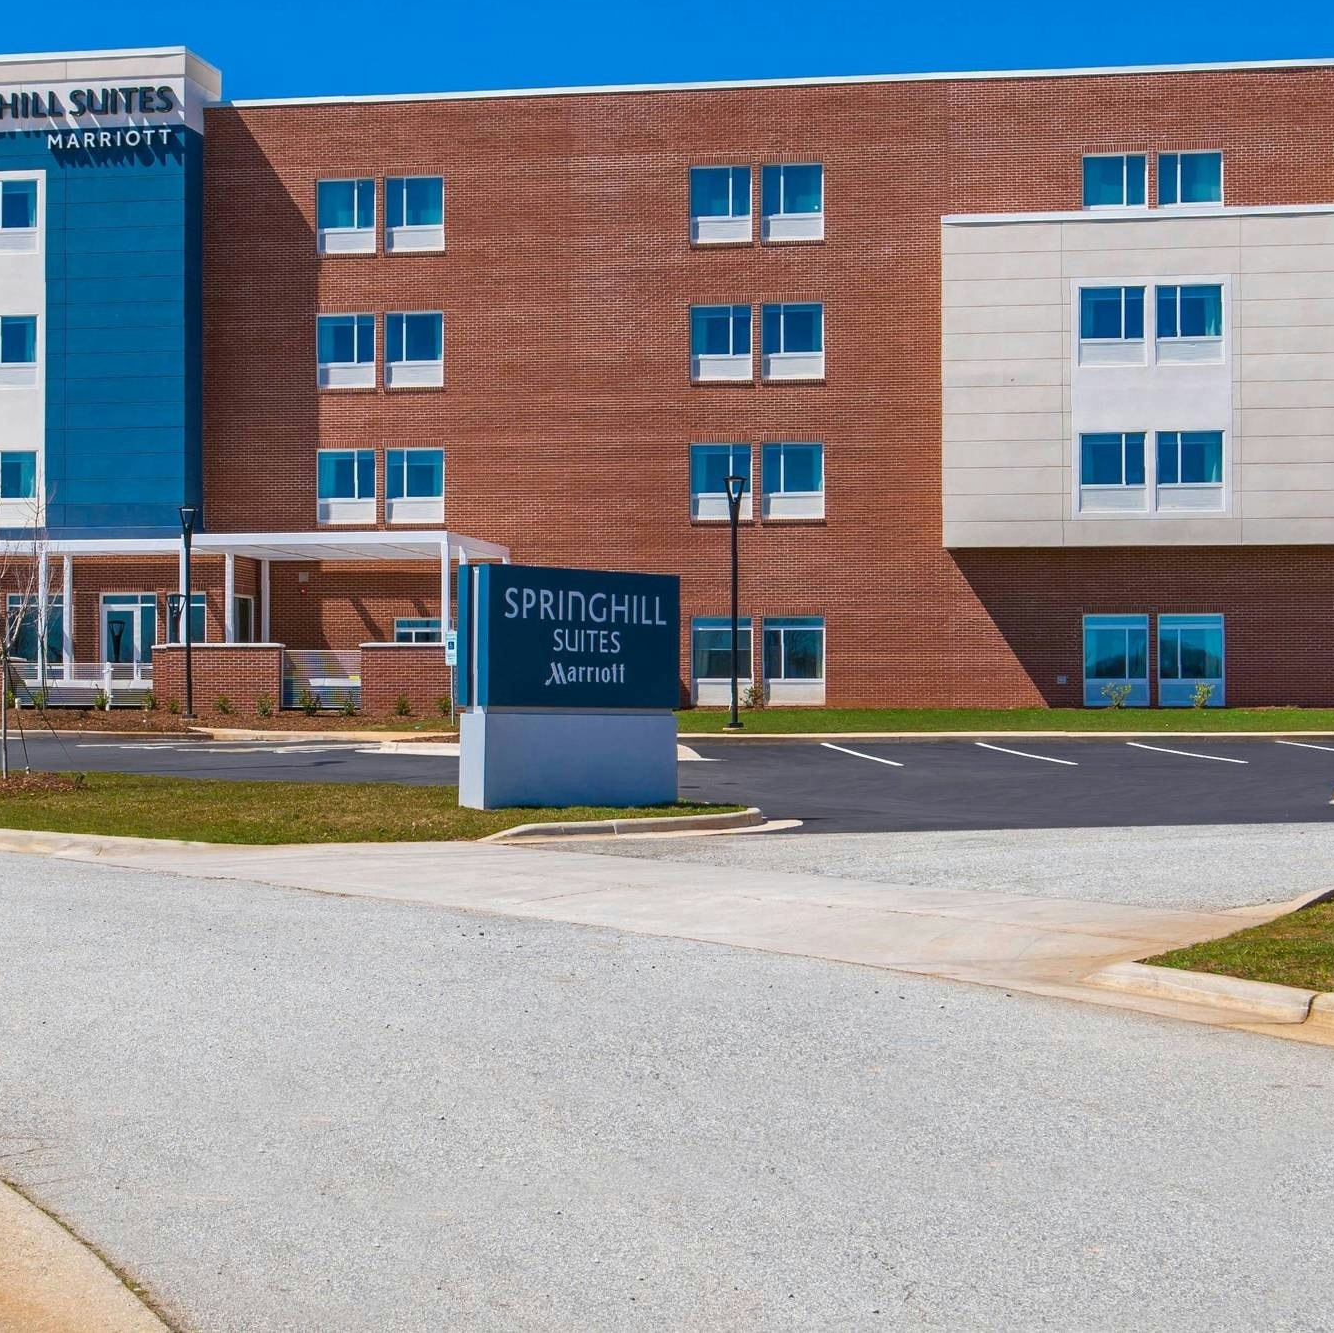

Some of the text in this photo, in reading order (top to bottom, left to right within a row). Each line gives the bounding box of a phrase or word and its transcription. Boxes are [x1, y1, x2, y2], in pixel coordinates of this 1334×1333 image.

[69, 86, 174, 116] SUITES
[48, 129, 172, 149] MARRIOTT
[504, 587, 667, 625] SPRINGHILL
[553, 628, 621, 653] SUITES
[545, 662, 625, 686] Marriott
